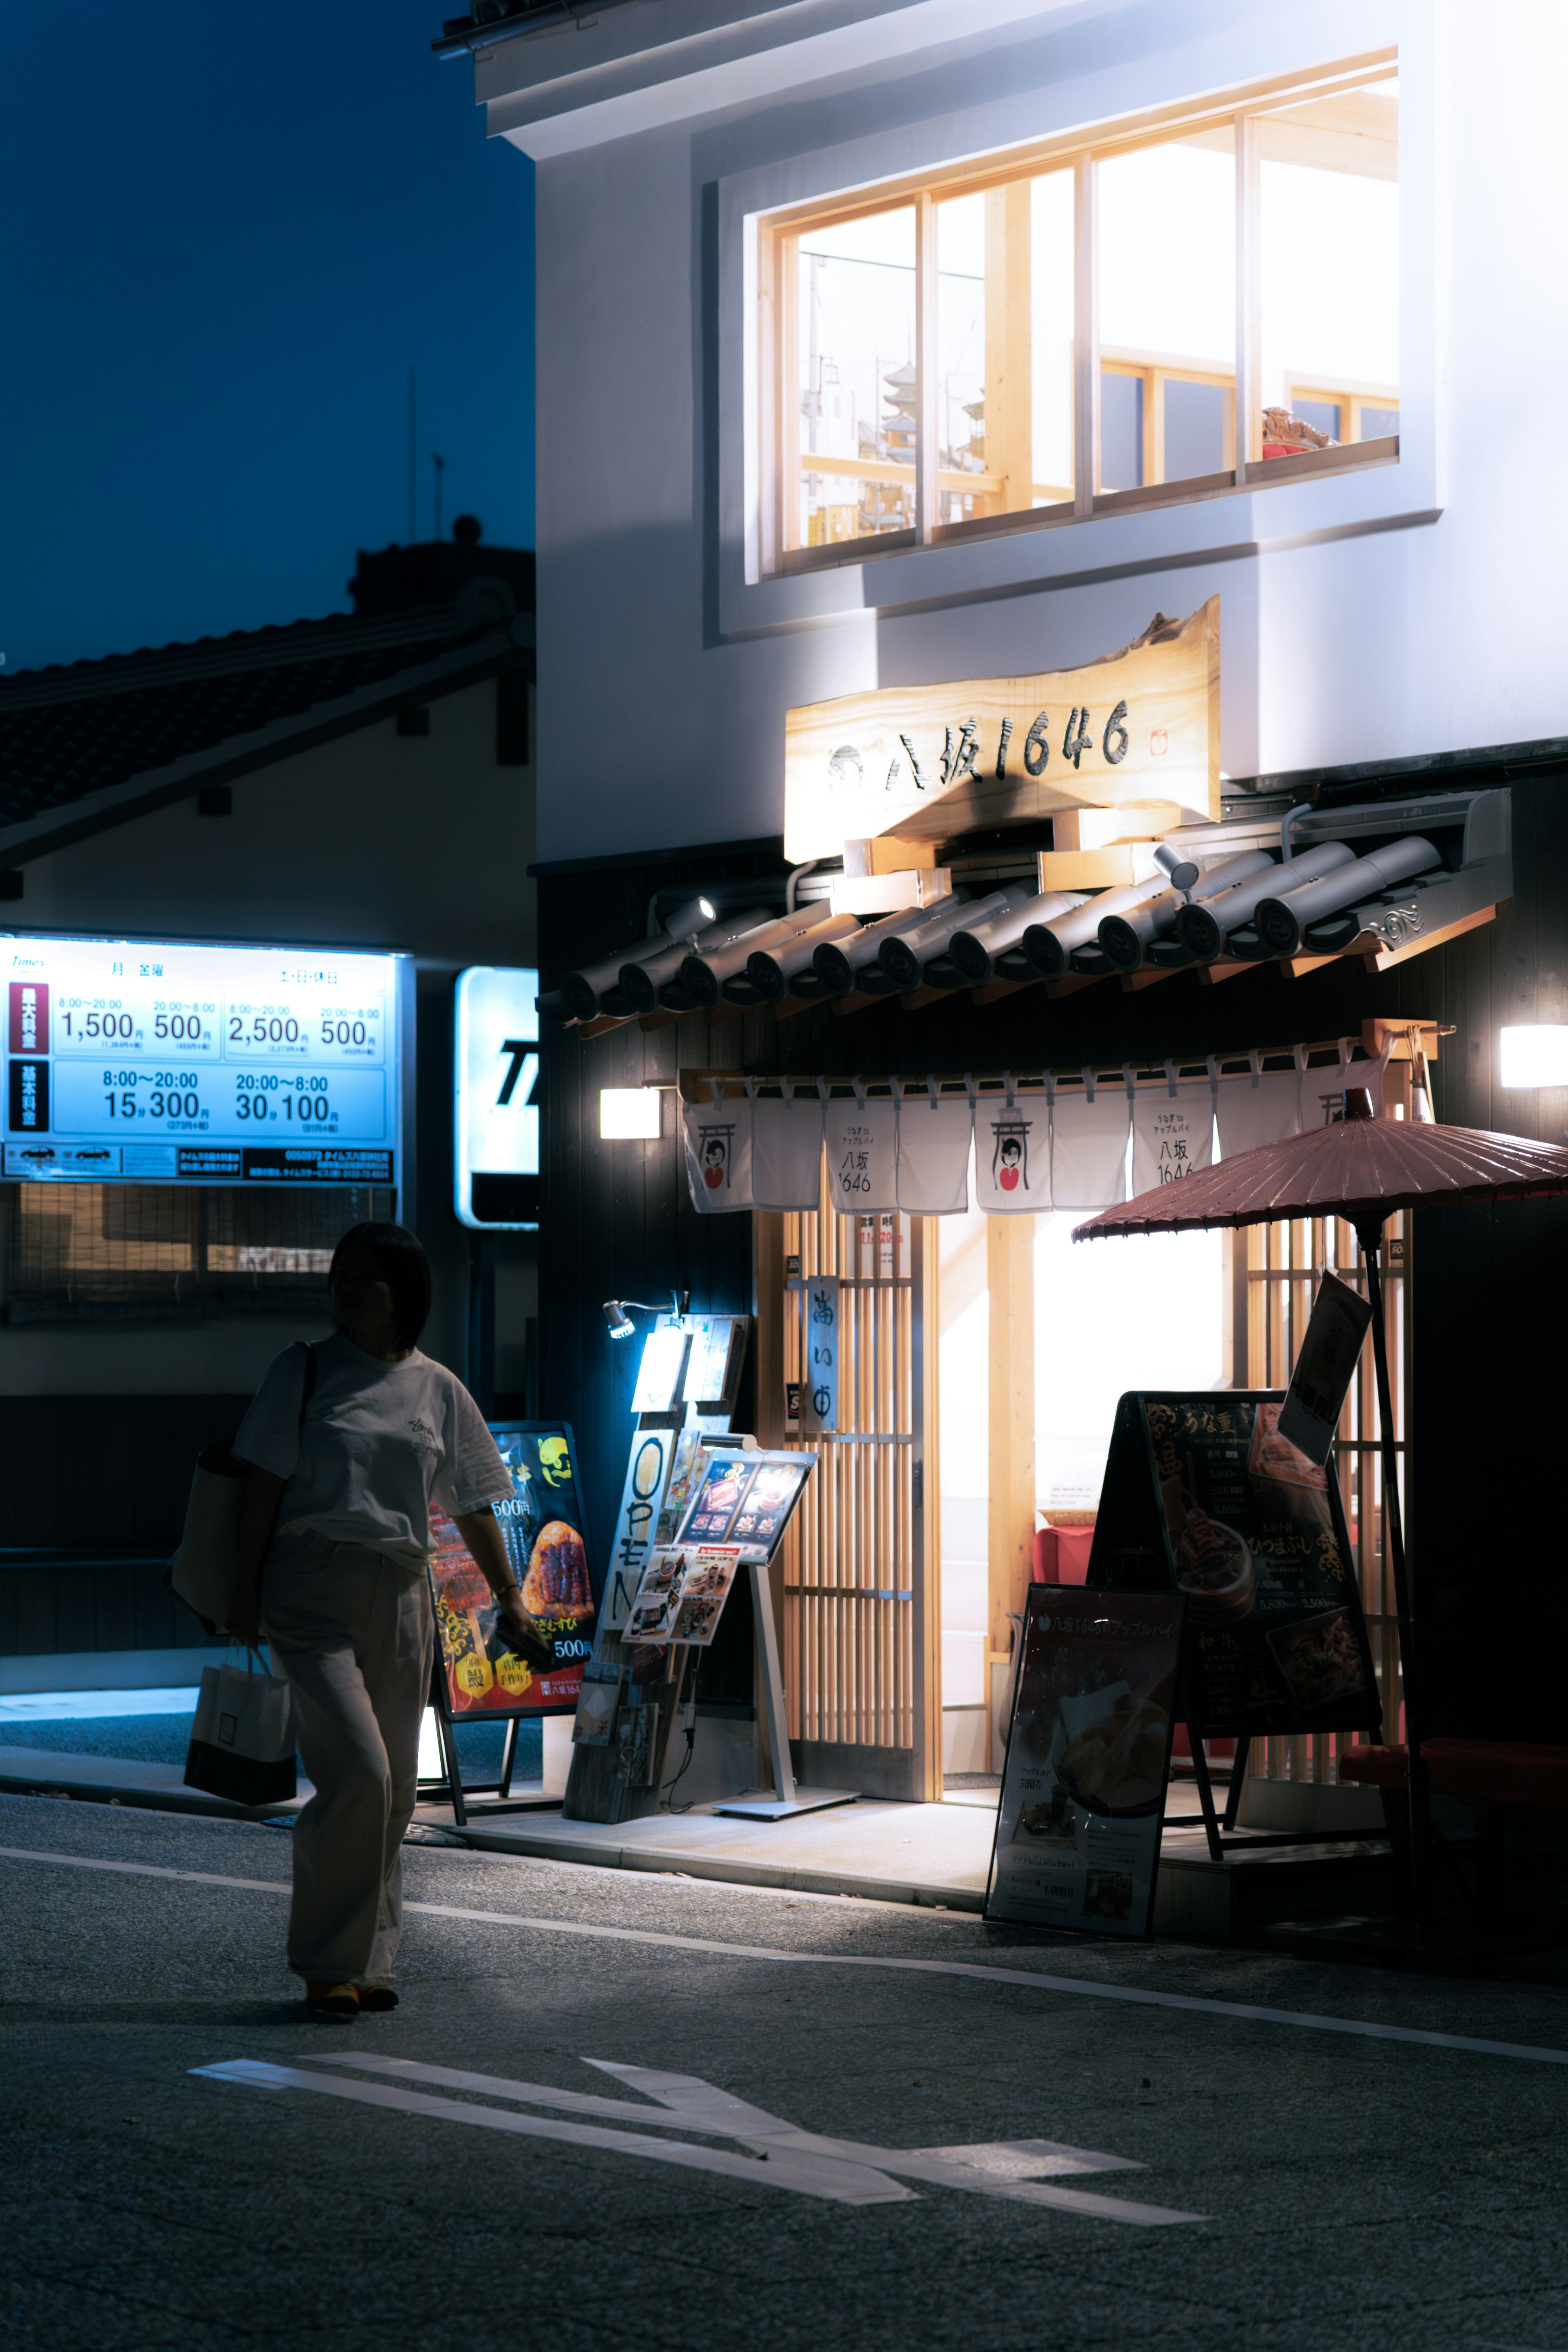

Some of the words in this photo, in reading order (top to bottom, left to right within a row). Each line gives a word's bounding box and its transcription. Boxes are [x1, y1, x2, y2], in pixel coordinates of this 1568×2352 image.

[13, 956, 44, 967] Times
[22, 1065, 36, 1126] 基本料金
[1160, 1140, 1188, 1160] 八坂
[842, 1151, 869, 1170] 八坂
[1185, 1411, 1236, 1434] うな重
[613, 1438, 663, 1620] OPEN
[1246, 1536, 1313, 1555] ひつまぶし
